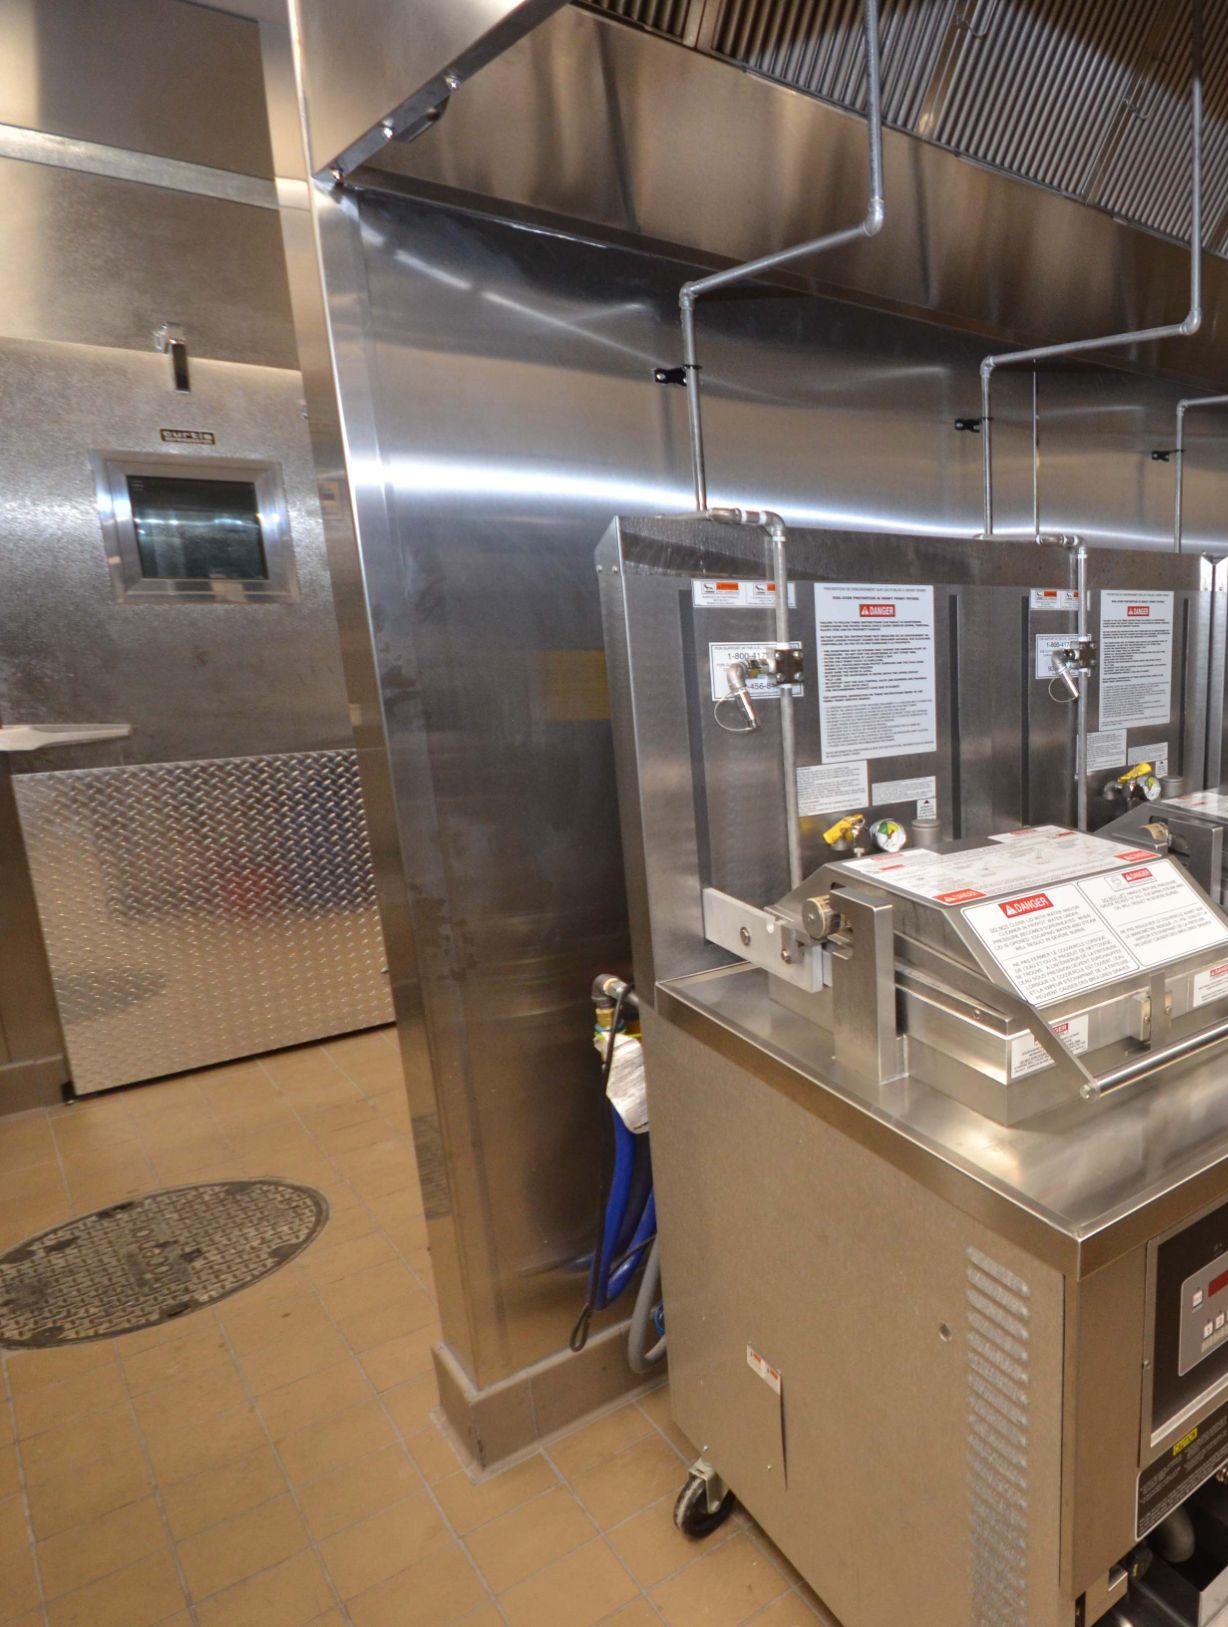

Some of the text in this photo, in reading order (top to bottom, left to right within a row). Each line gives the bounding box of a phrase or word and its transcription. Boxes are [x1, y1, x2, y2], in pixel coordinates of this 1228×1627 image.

[870, 606, 894, 615] DANGER
[1127, 870, 1150, 880] DANGER
[1014, 896, 1048, 912] DANGER
